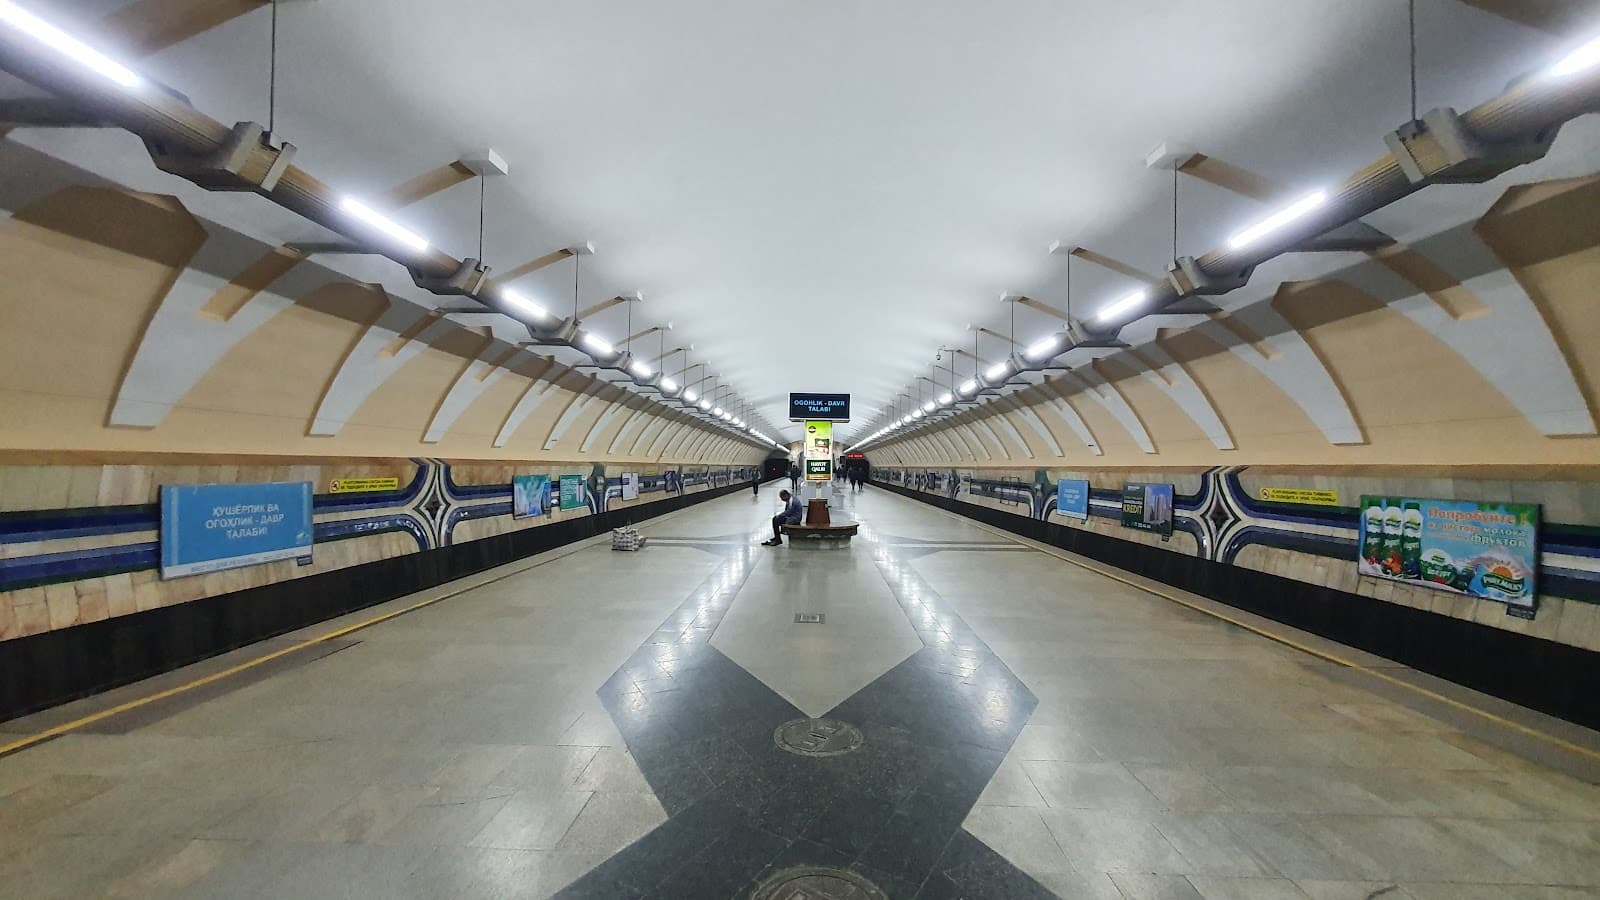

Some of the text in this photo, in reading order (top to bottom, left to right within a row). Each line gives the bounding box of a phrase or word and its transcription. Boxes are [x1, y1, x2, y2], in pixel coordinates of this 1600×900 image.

[267, 503, 280, 513] ВА
[1123, 504, 1143, 515] KREDIT
[260, 513, 284, 525] ДАВР
